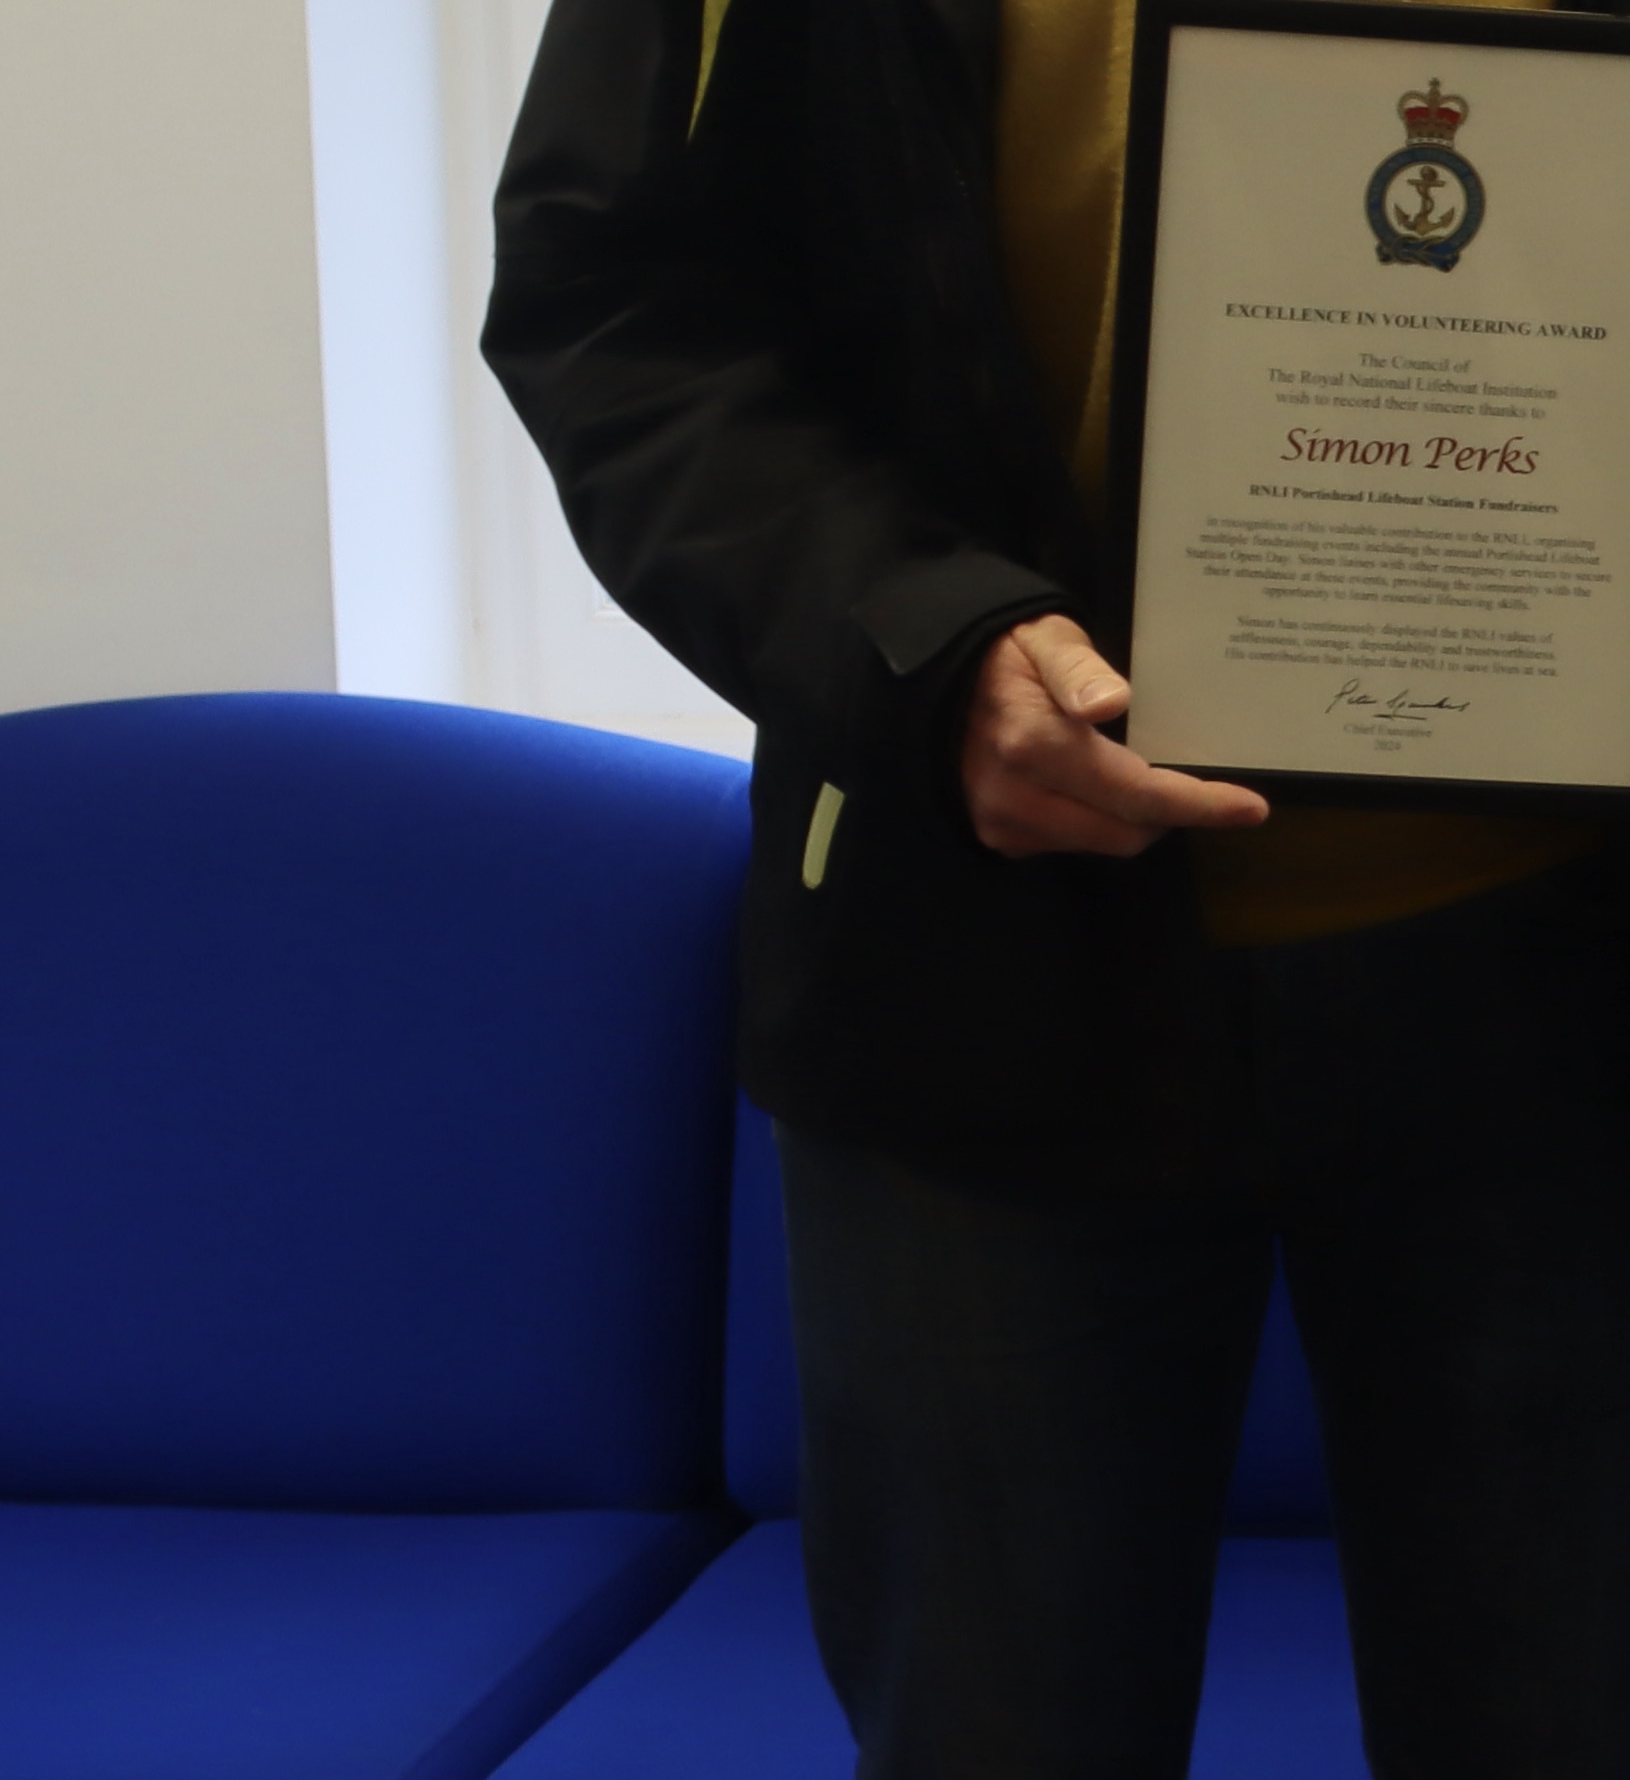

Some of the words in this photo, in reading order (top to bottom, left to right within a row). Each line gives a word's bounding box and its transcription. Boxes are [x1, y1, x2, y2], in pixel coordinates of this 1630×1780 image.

[1225, 302, 1350, 324] EXCELLENCE
[1356, 310, 1376, 325] IN
[1382, 312, 1531, 336] VOLUNTEERING
[1536, 322, 1607, 340] AWARD
[1280, 427, 1411, 468] Simon
[1424, 436, 1540, 476] Perks
